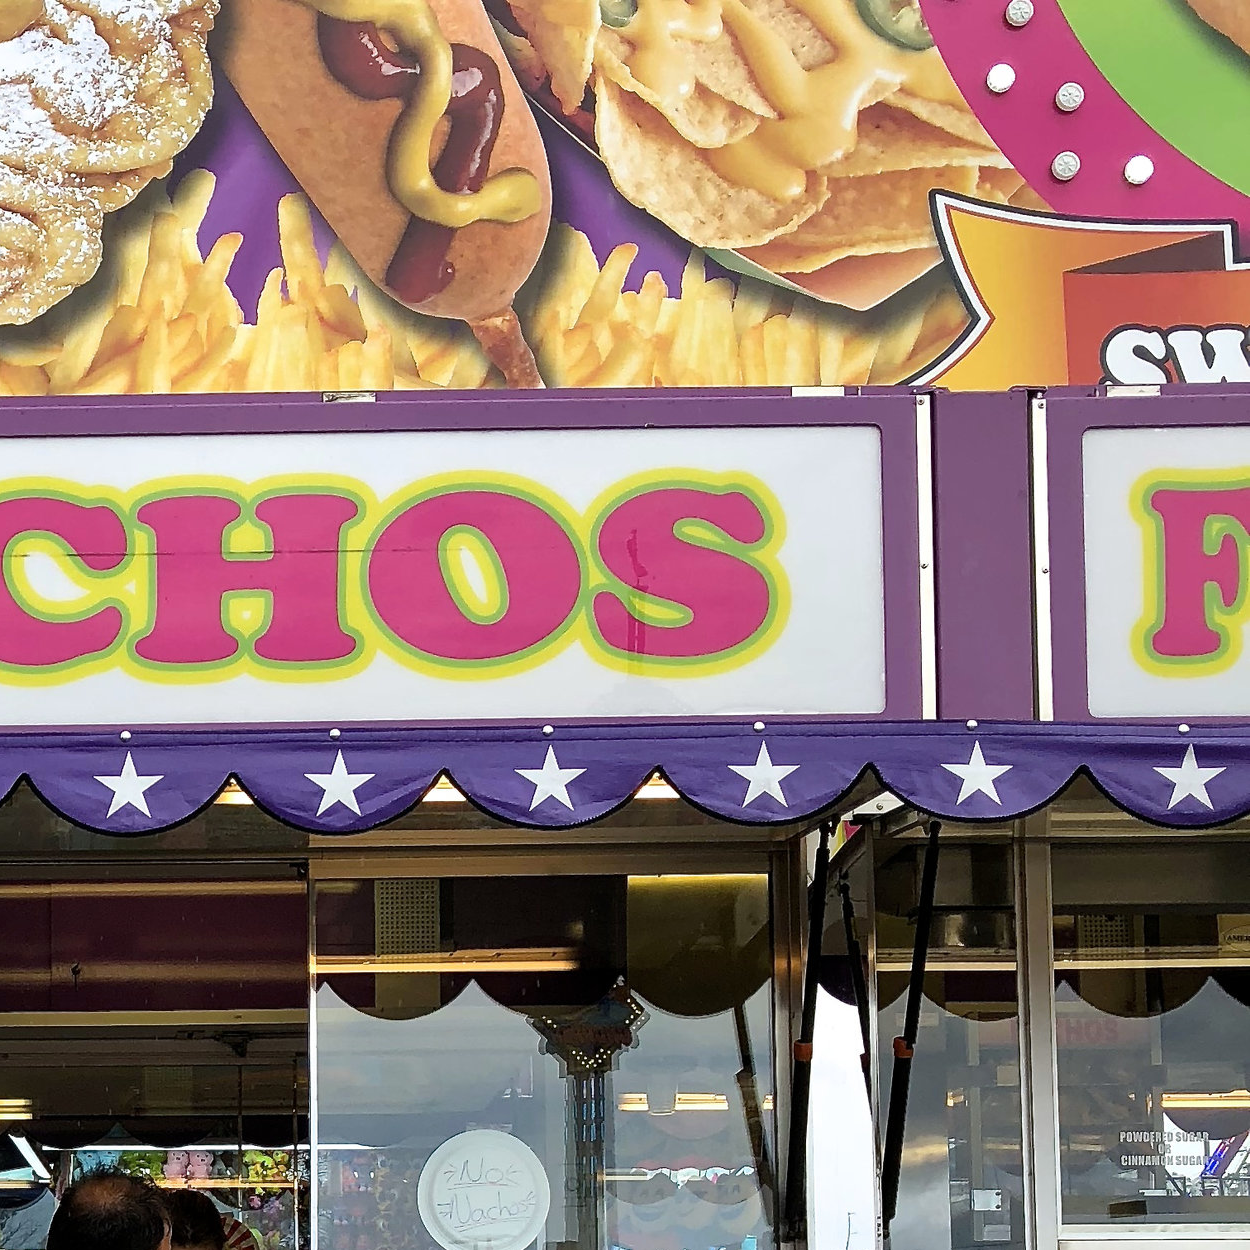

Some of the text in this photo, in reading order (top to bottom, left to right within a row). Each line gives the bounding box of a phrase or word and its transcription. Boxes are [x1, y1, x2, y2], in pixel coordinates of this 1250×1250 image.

[1119, 1131, 1209, 1142] POWDERED SUGAR
[1121, 1155, 1209, 1166] CINNAMON SUGAR
[459, 1157, 504, 1183] No
[450, 1191, 529, 1224] Nachos
